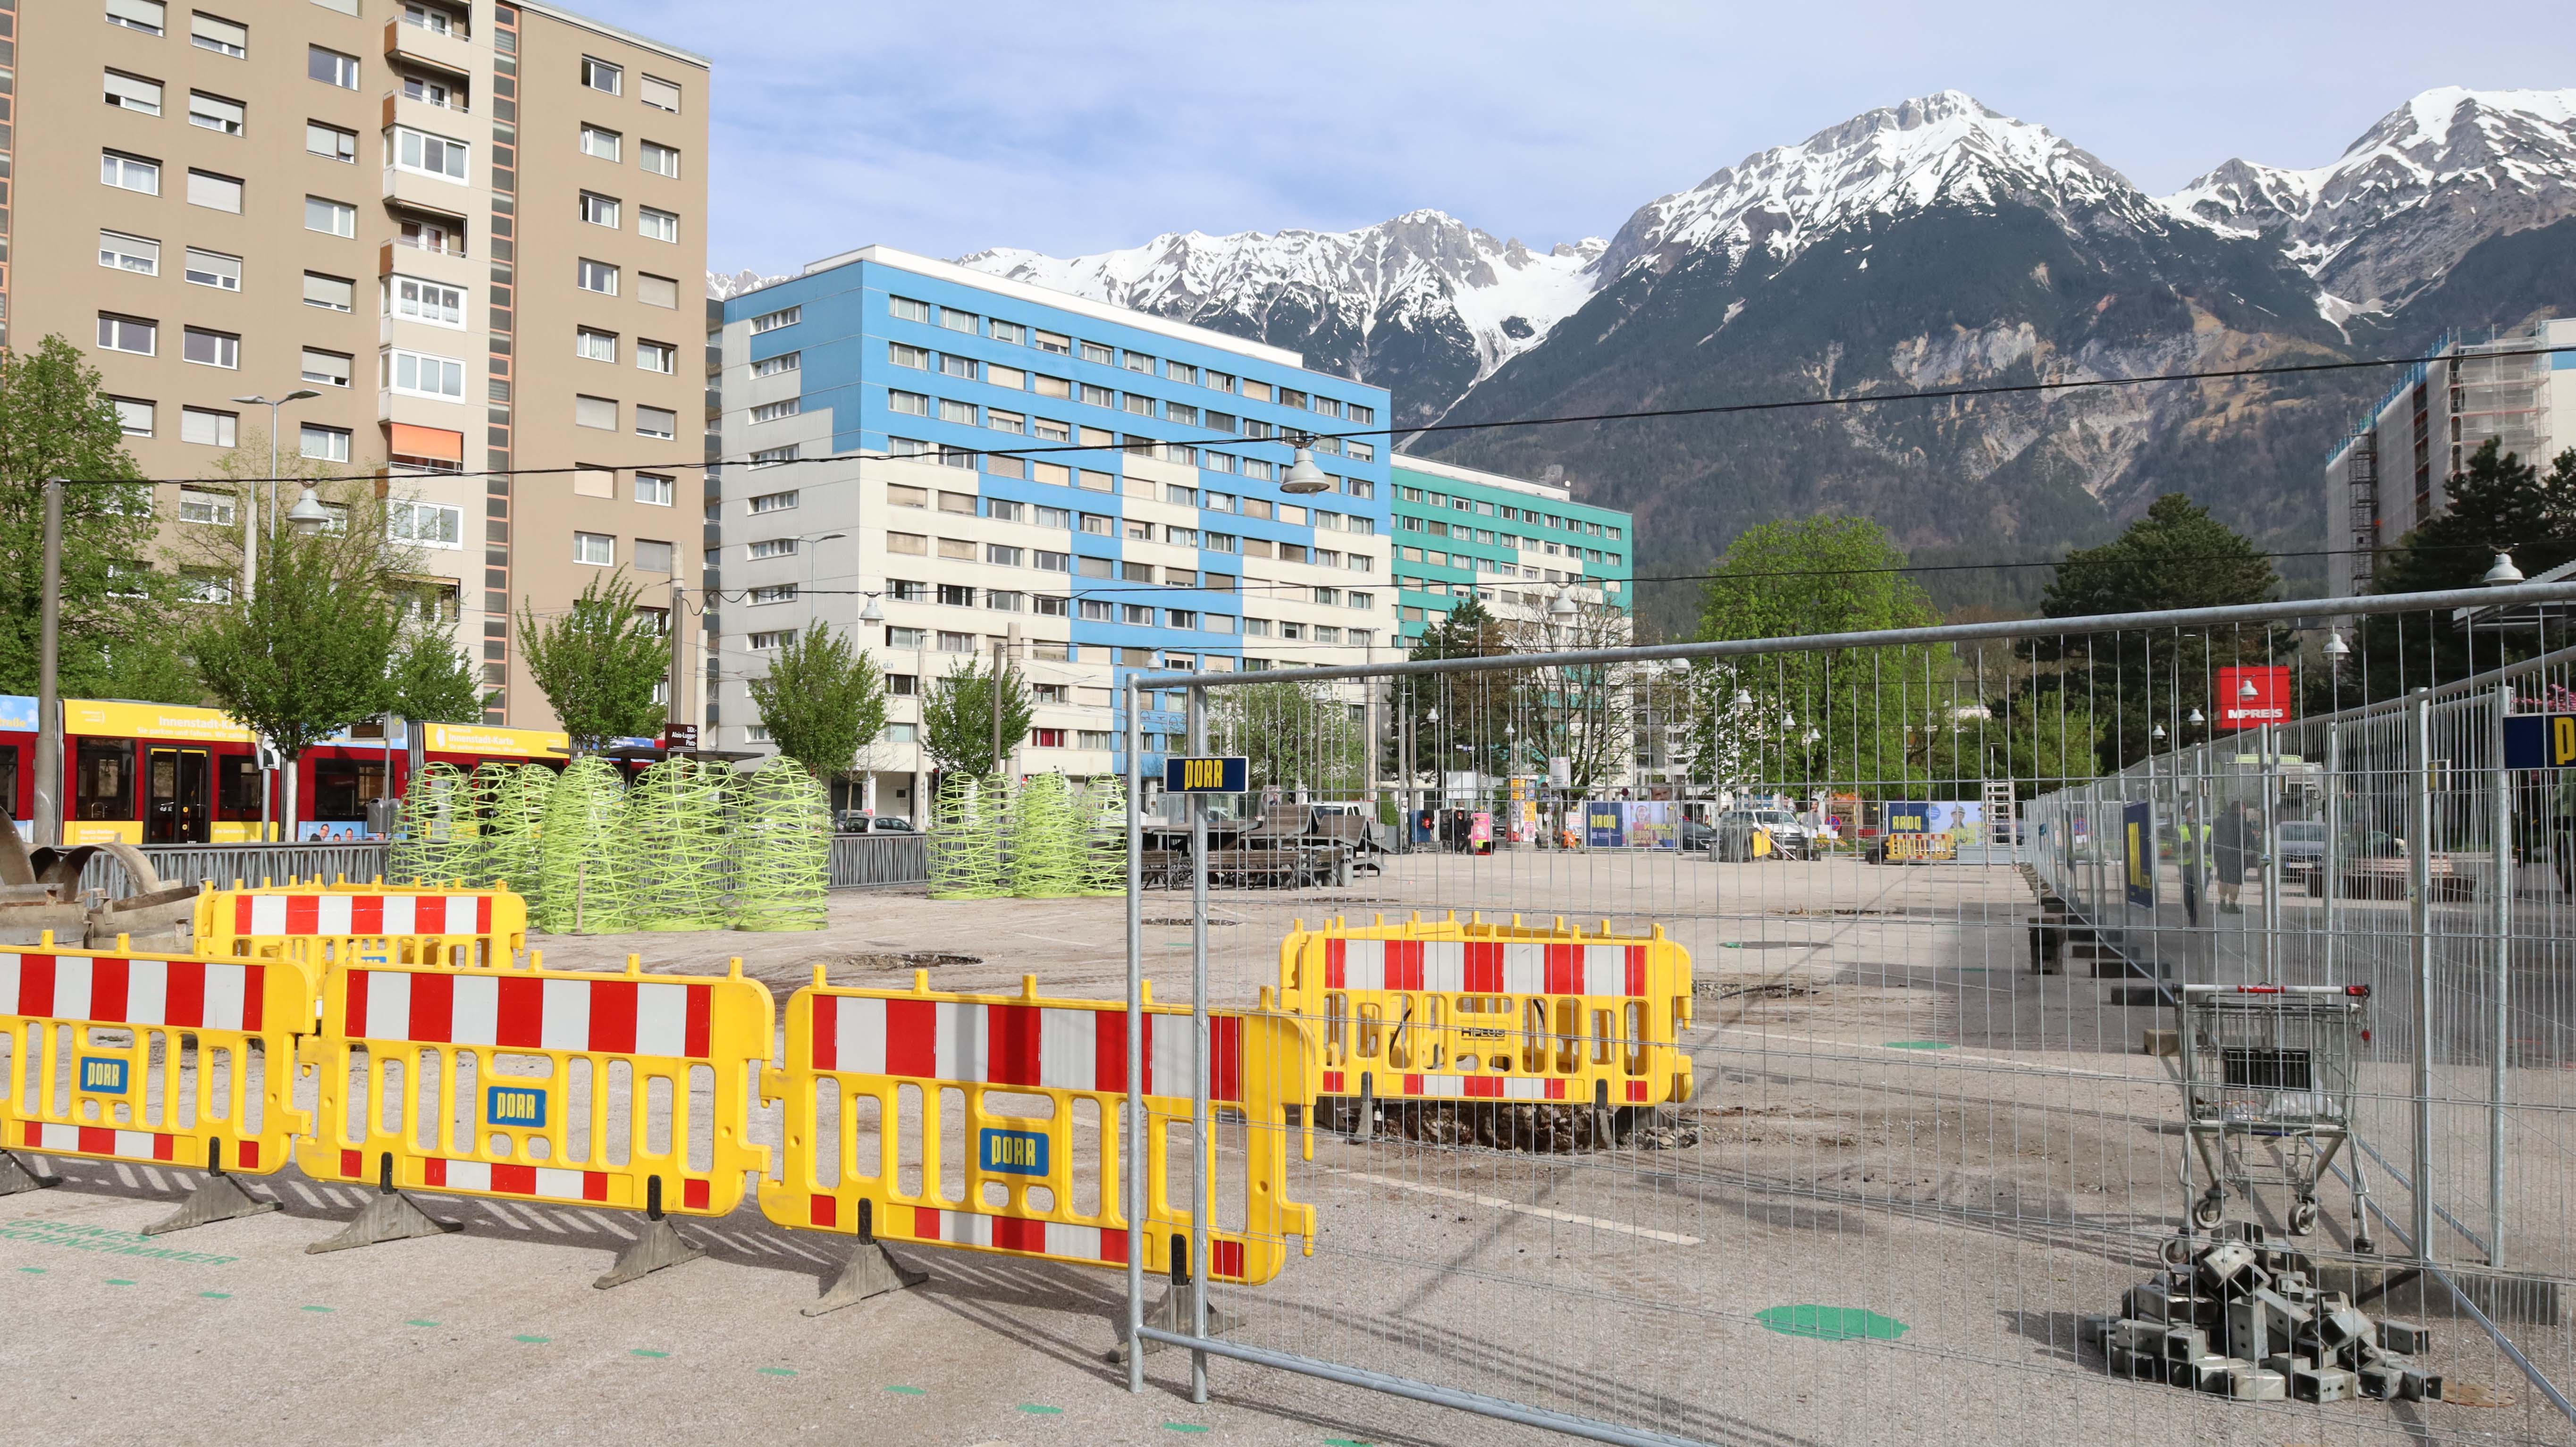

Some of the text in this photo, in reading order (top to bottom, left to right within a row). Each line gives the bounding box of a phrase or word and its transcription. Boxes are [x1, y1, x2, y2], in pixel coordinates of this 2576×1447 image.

[2228, 709, 2283, 718] MPREIS
[1185, 760, 1223, 790] PORR
[88, 1062, 119, 1086] PORR
[497, 1093, 535, 1119] PORR
[992, 1135, 1035, 1166] PORR
